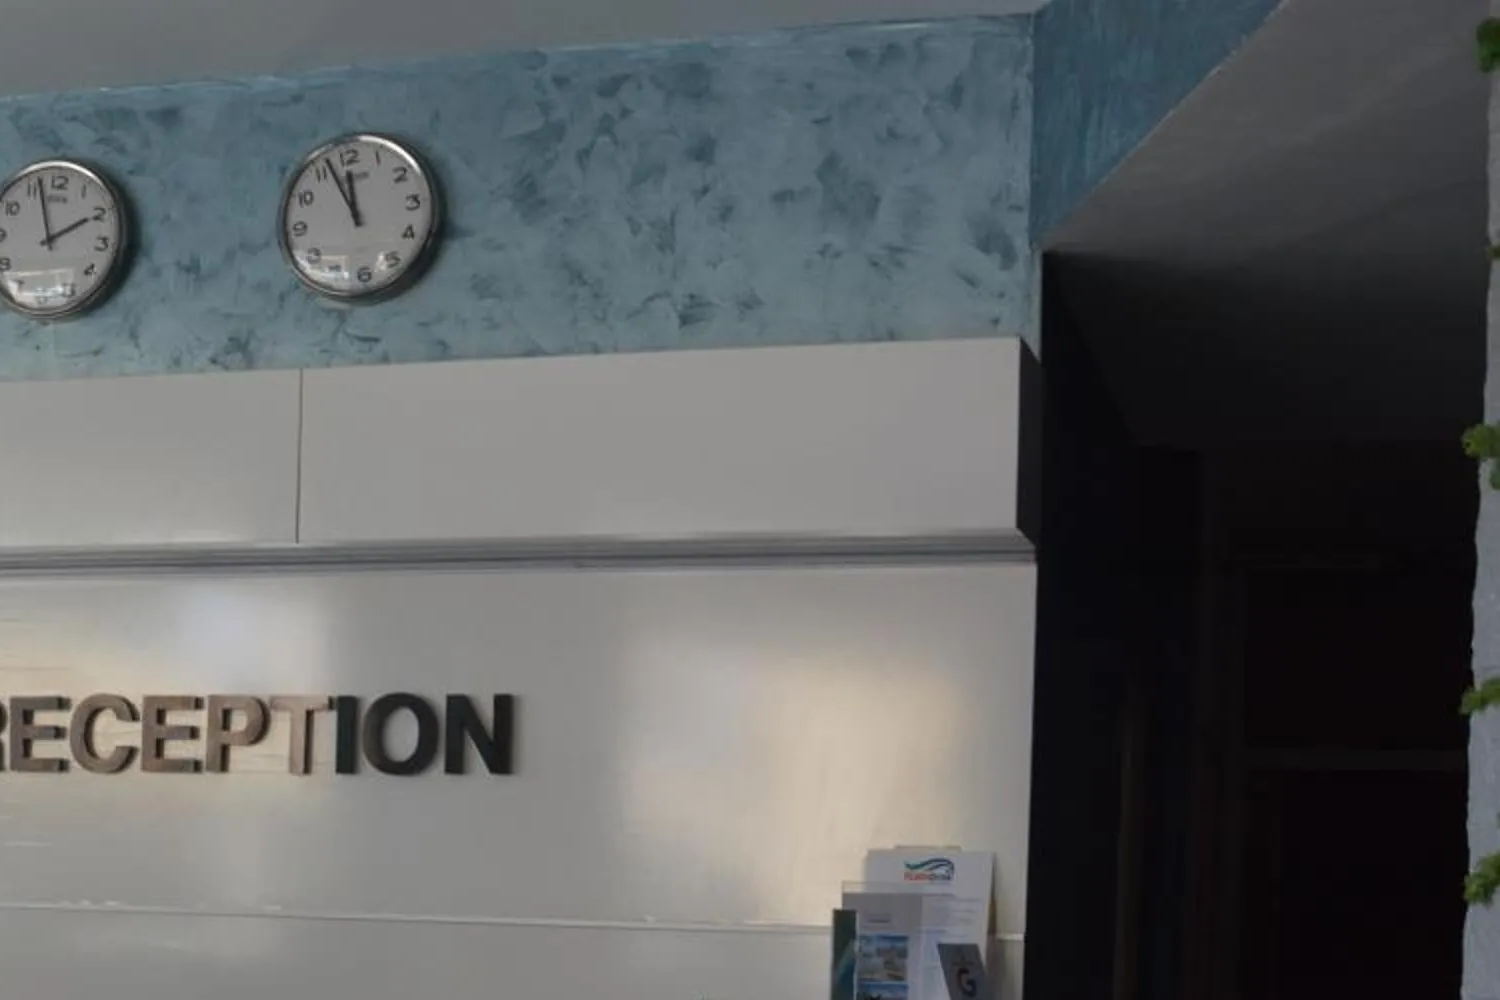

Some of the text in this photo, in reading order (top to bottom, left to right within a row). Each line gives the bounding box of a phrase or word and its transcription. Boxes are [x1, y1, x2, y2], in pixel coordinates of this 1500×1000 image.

[340, 149, 360, 165] 12
[51, 175, 69, 190] 12
[316, 167, 328, 183] 11
[393, 167, 407, 183] 2
[27, 184, 37, 200] 11
[298, 190, 314, 207] 10
[5, 201, 20, 216] 10
[405, 194, 421, 211] 3
[92, 207, 106, 222] 2
[292, 221, 308, 237] 9
[401, 224, 415, 240] 4
[94, 236, 109, 252] 3
[83, 263, 96, 277] 4
[357, 266, 372, 283] 6
